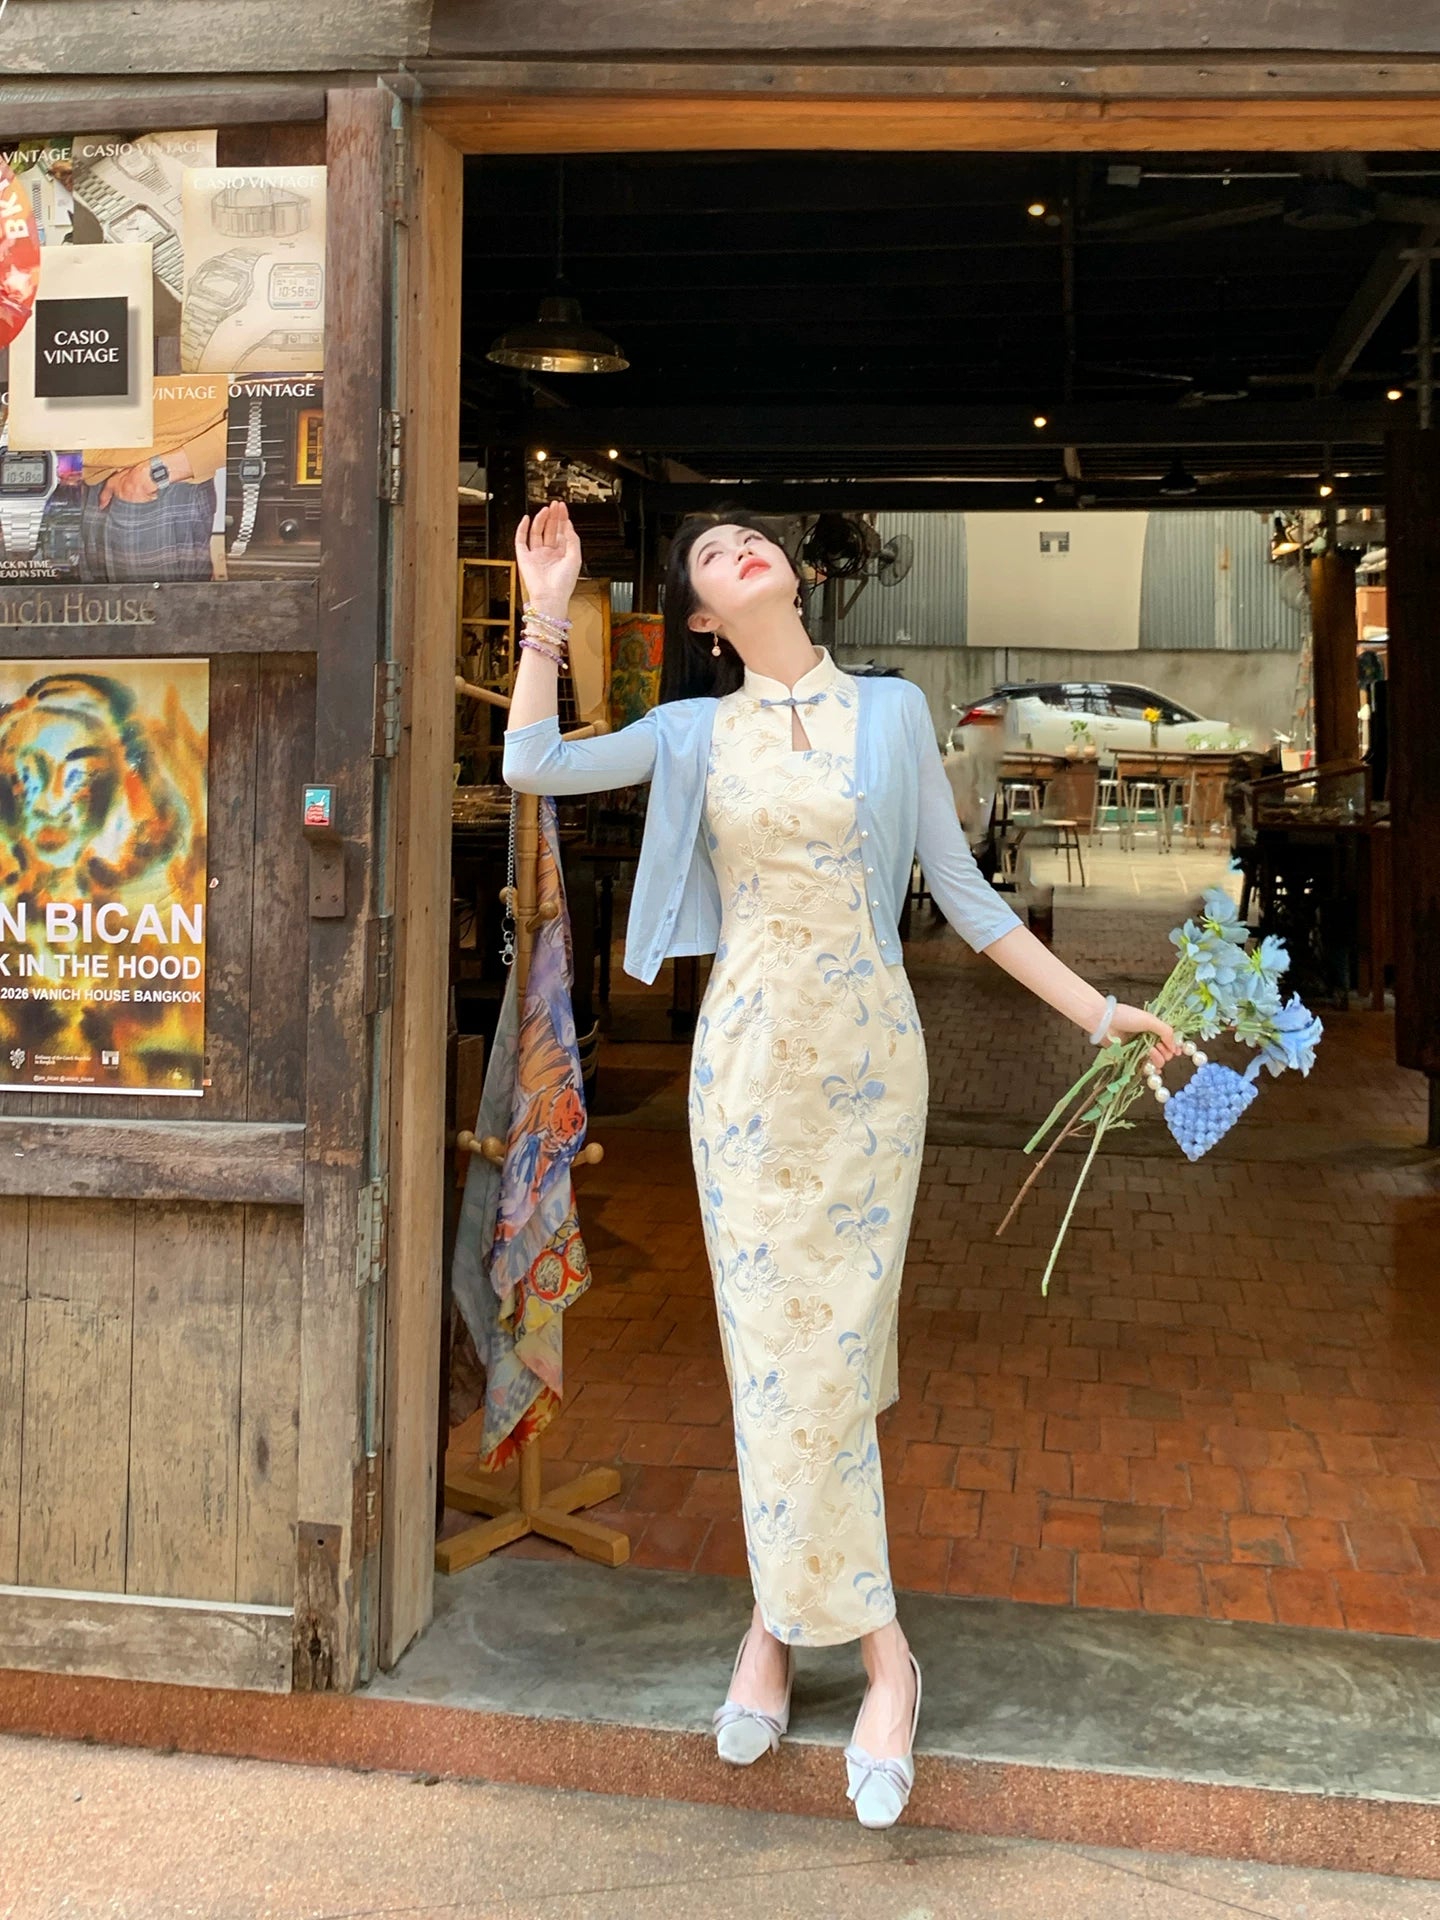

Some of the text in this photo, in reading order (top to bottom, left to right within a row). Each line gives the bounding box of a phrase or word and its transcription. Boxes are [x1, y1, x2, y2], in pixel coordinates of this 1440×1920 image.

[3, 147, 71, 164] VINTAGE
[82, 143, 133, 158] CASIO
[193, 174, 319, 190] CASIO VINTAGE
[54, 329, 110, 346] CASIO
[43, 347, 120, 364] VINTAGE
[245, 383, 316, 398] VINTAGE
[17, 560, 28, 569] IN
[19, 569, 30, 578] IN
[30, 568, 58, 578] STYLE
[63, 591, 158, 625] House
[0, 902, 203, 944] N BICAN
[19, 953, 45, 977] IN
[53, 953, 109, 978] THE
[118, 955, 201, 980] HOOD
[1, 987, 202, 1003] 2026 VANICH HOUSE BANGKOK
